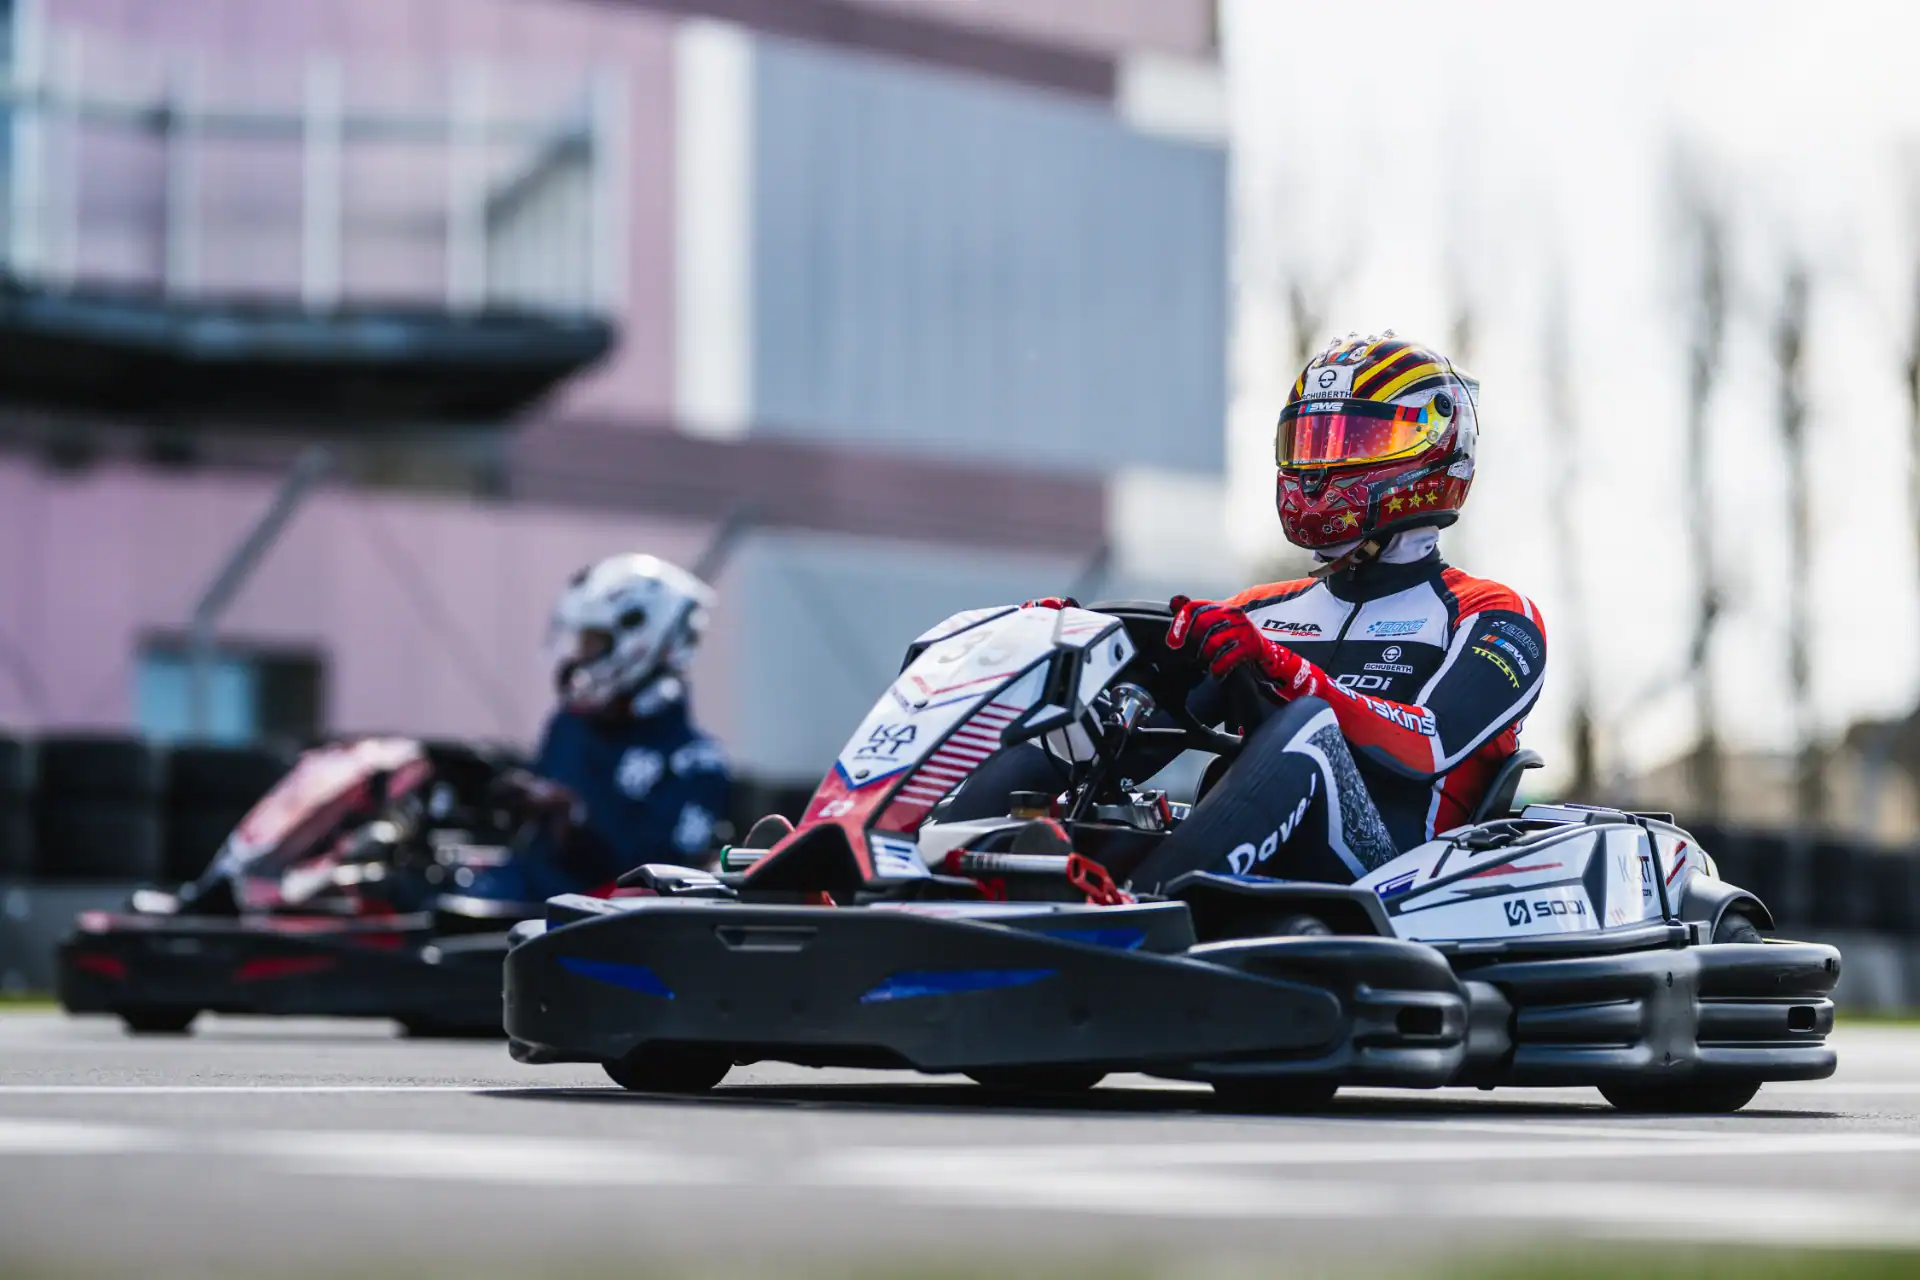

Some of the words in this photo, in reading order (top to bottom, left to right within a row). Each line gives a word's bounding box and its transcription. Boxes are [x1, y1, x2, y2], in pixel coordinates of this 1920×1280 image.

[1309, 402, 1344, 412] SWS
[1263, 619, 1322, 632] ITAKA
[1364, 663, 1413, 673] SCHUBERTH
[1533, 899, 1586, 917] SODI
